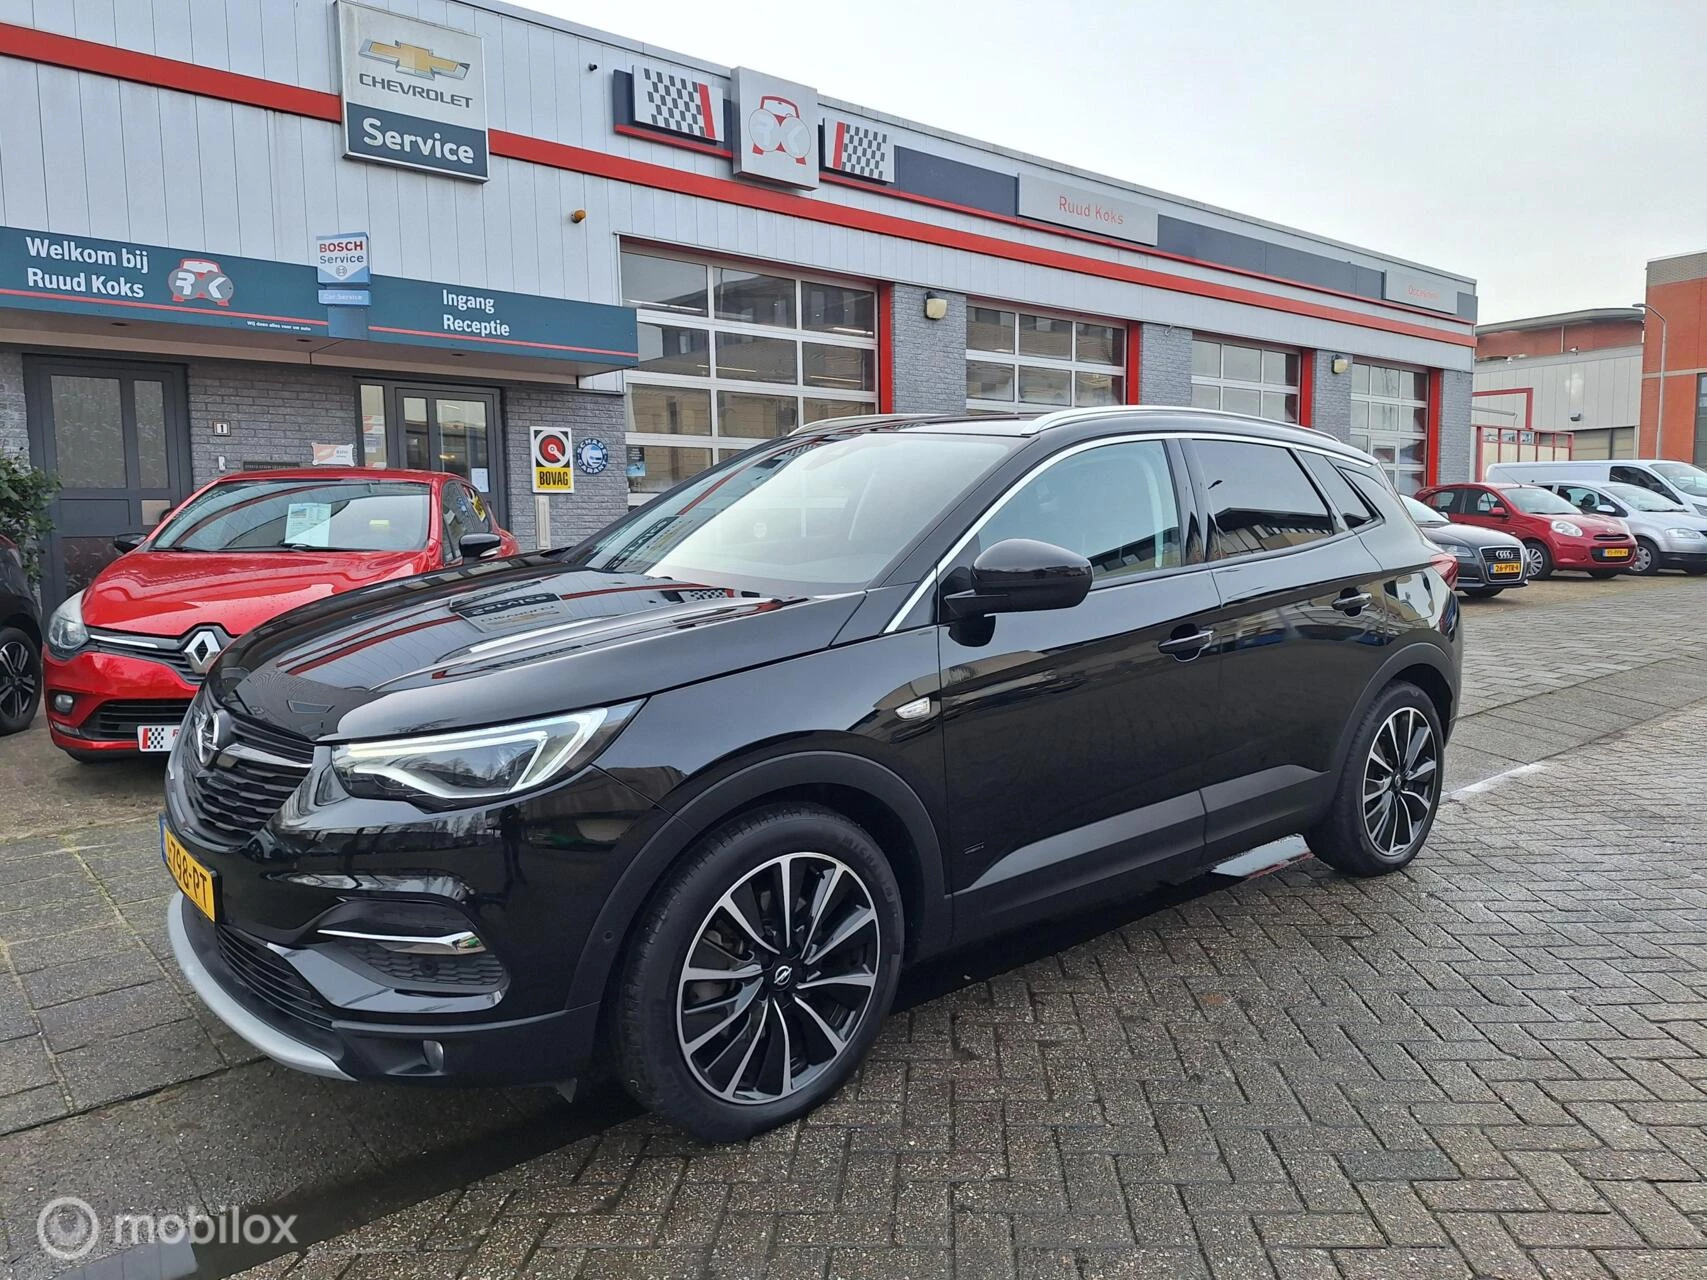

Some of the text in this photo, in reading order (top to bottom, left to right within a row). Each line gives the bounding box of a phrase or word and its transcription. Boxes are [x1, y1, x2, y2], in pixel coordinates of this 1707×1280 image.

[359, 73, 473, 108] CHEVROLET
[363, 117, 474, 164] Service
[1059, 195, 1124, 225] Ruud Koks
[25, 236, 148, 274] Welkom bij
[319, 240, 363, 253] BOSCH
[319, 254, 364, 265] Service
[27, 267, 144, 298] Ruud Koks
[443, 289, 494, 313] Ingang
[443, 314, 510, 336] Receptie
[577, 438, 607, 454] SCHADE
[577, 459, 607, 474] GARANT
[539, 471, 569, 486] BOVAG
